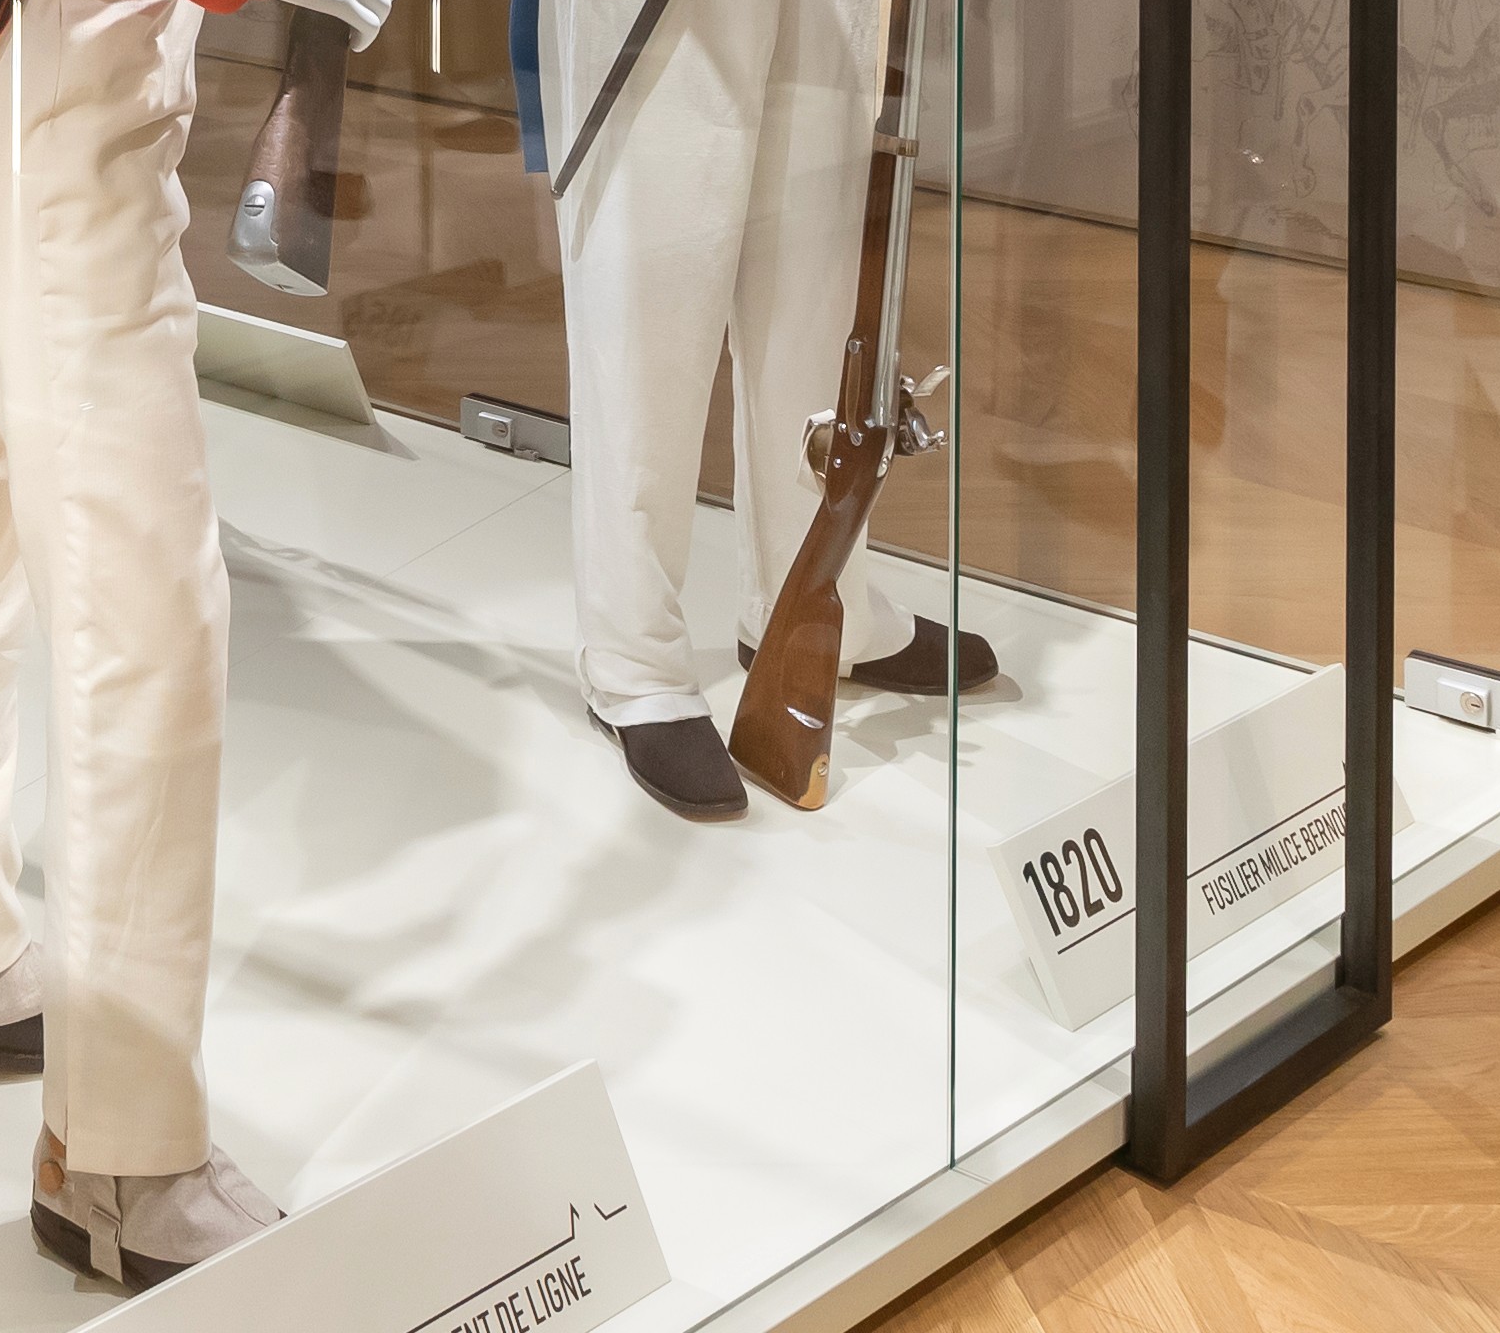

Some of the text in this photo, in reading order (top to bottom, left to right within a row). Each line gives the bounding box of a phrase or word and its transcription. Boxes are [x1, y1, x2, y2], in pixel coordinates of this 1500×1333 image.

[1022, 826, 1125, 939] 1820
[1201, 857, 1266, 917] FUSILIER
[1257, 831, 1308, 882] MILICE
[493, 1291, 531, 1333] DE
[524, 1254, 593, 1327] LIGNE
